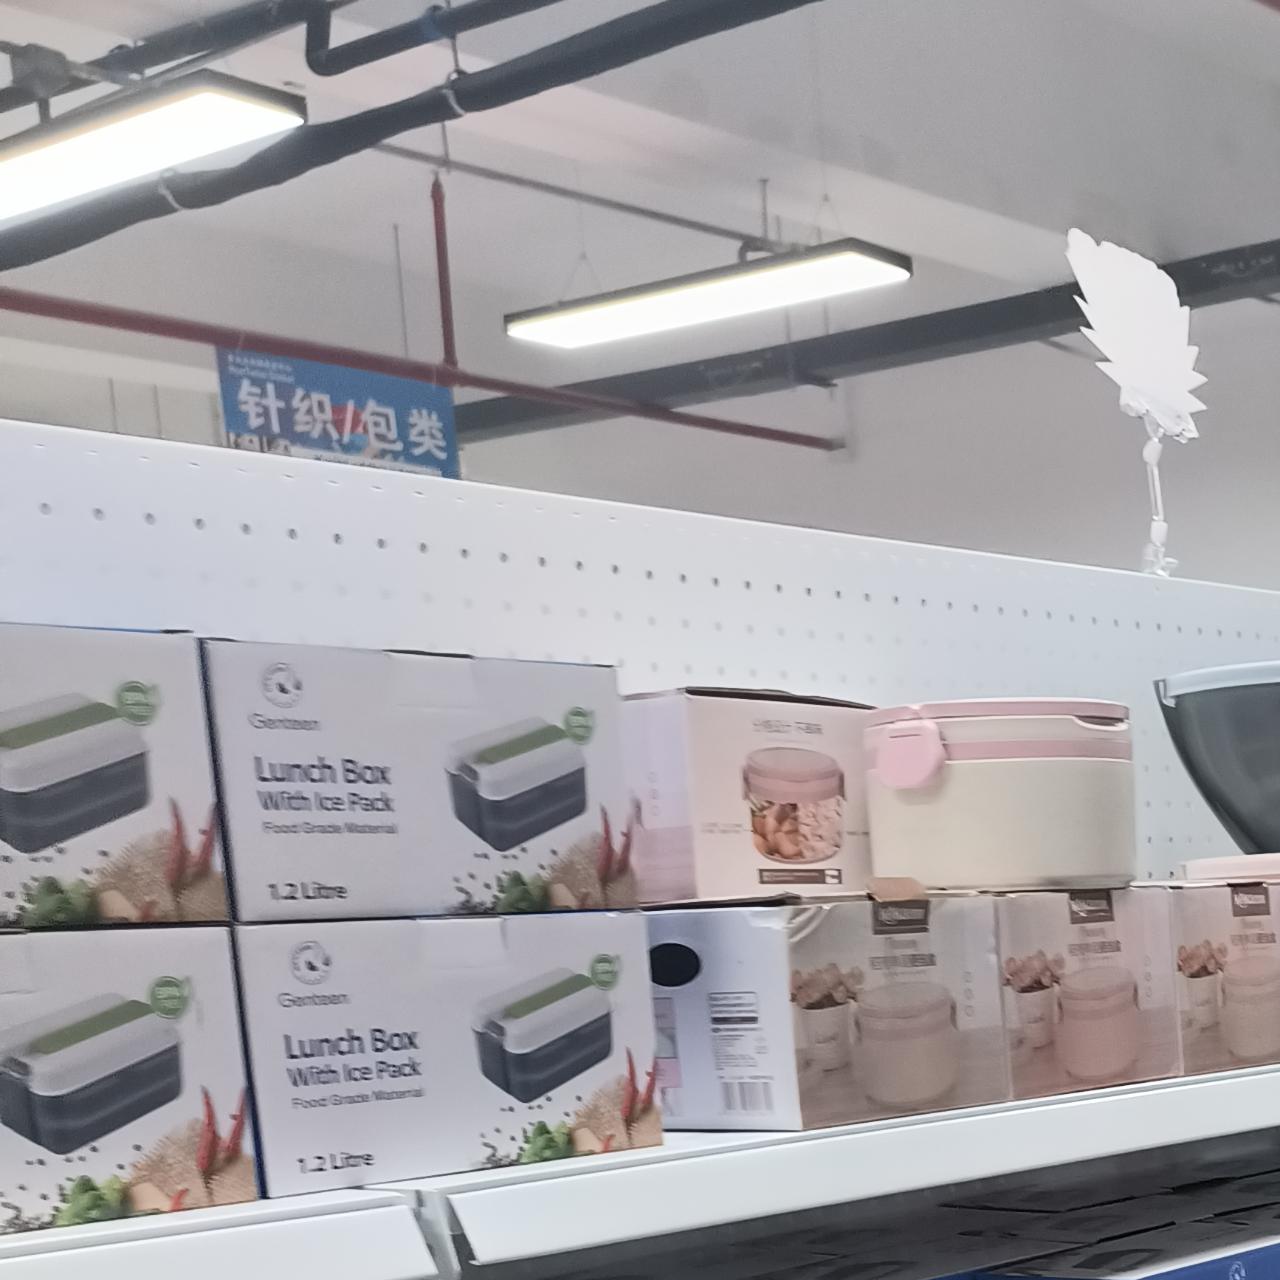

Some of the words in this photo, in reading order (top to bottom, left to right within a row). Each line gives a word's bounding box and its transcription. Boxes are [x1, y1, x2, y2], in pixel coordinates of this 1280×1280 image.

[238, 377, 448, 461] 针织/包类
[253, 755, 338, 784] Lunch
[340, 757, 393, 786] Box
[256, 789, 312, 812] With
[314, 790, 347, 812] Ice
[347, 790, 397, 813] Pack
[262, 820, 301, 835] Food
[268, 883, 297, 902] 1.2
[300, 881, 348, 901] Litre
[283, 1028, 365, 1060] Lunch
[370, 1028, 421, 1053] Box
[286, 1064, 341, 1088] With
[342, 1063, 374, 1082] Ice
[375, 1056, 424, 1080] Pack
[291, 1096, 328, 1109] Food
[297, 1154, 326, 1174] 1.2
[329, 1151, 375, 1171] Litre
